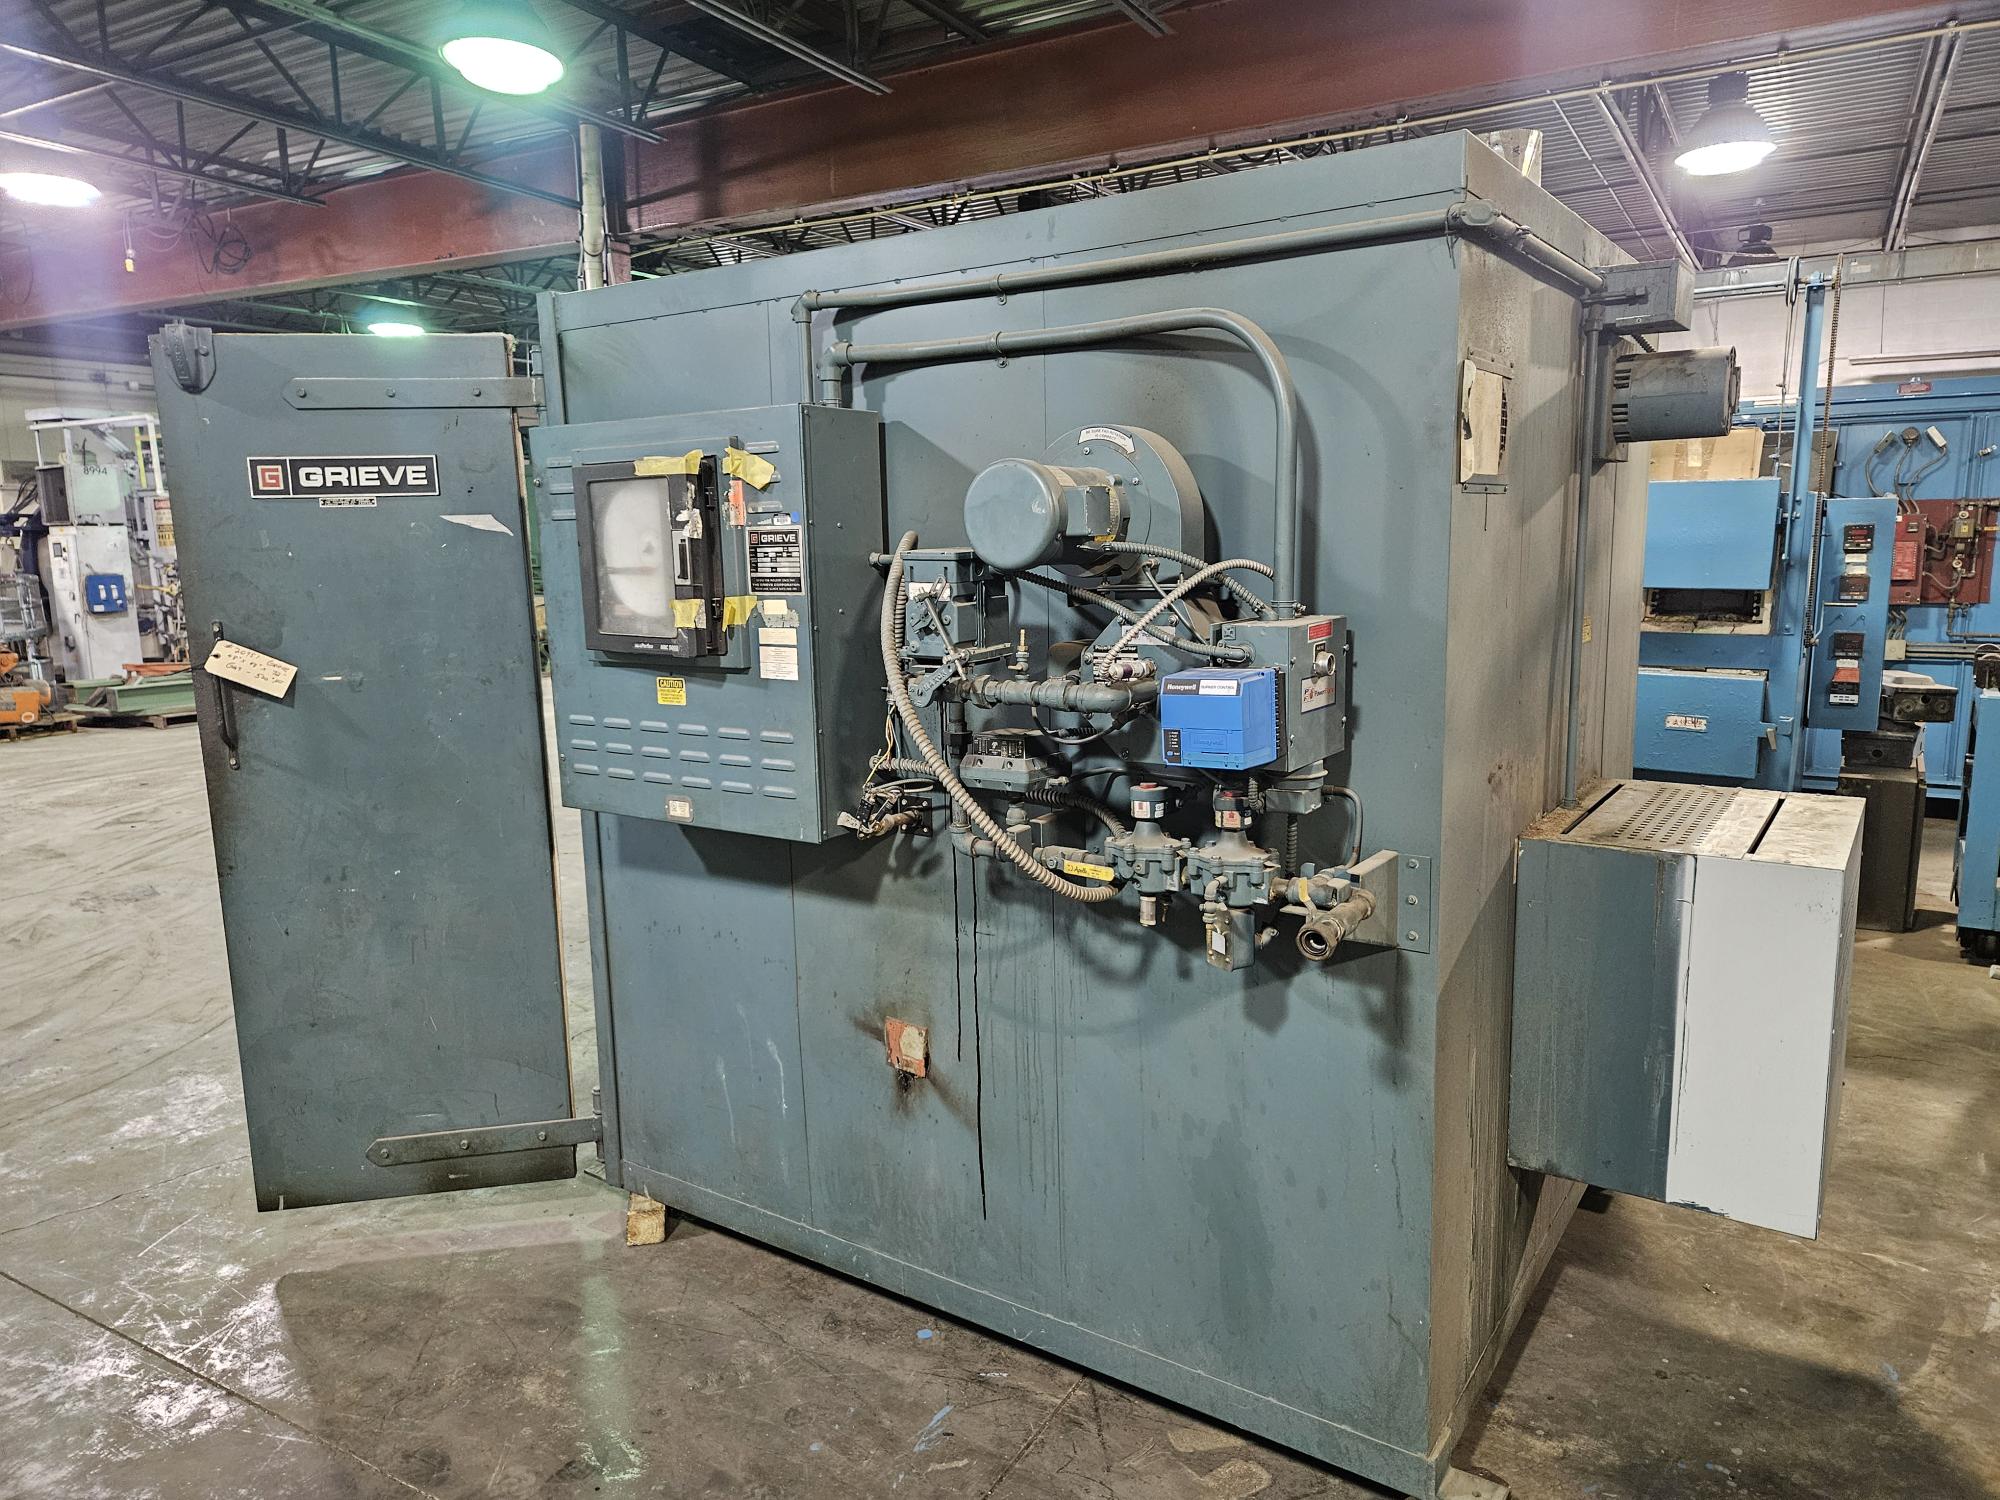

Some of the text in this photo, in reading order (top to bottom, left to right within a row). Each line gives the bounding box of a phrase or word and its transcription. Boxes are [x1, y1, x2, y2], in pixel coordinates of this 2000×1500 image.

[84, 465, 107, 475] 8994
[298, 465, 428, 487] GRIEVE
[761, 534, 796, 543] GRIEVE
[660, 679, 683, 688] CAUTION
[1167, 683, 1197, 691] Honeywell
